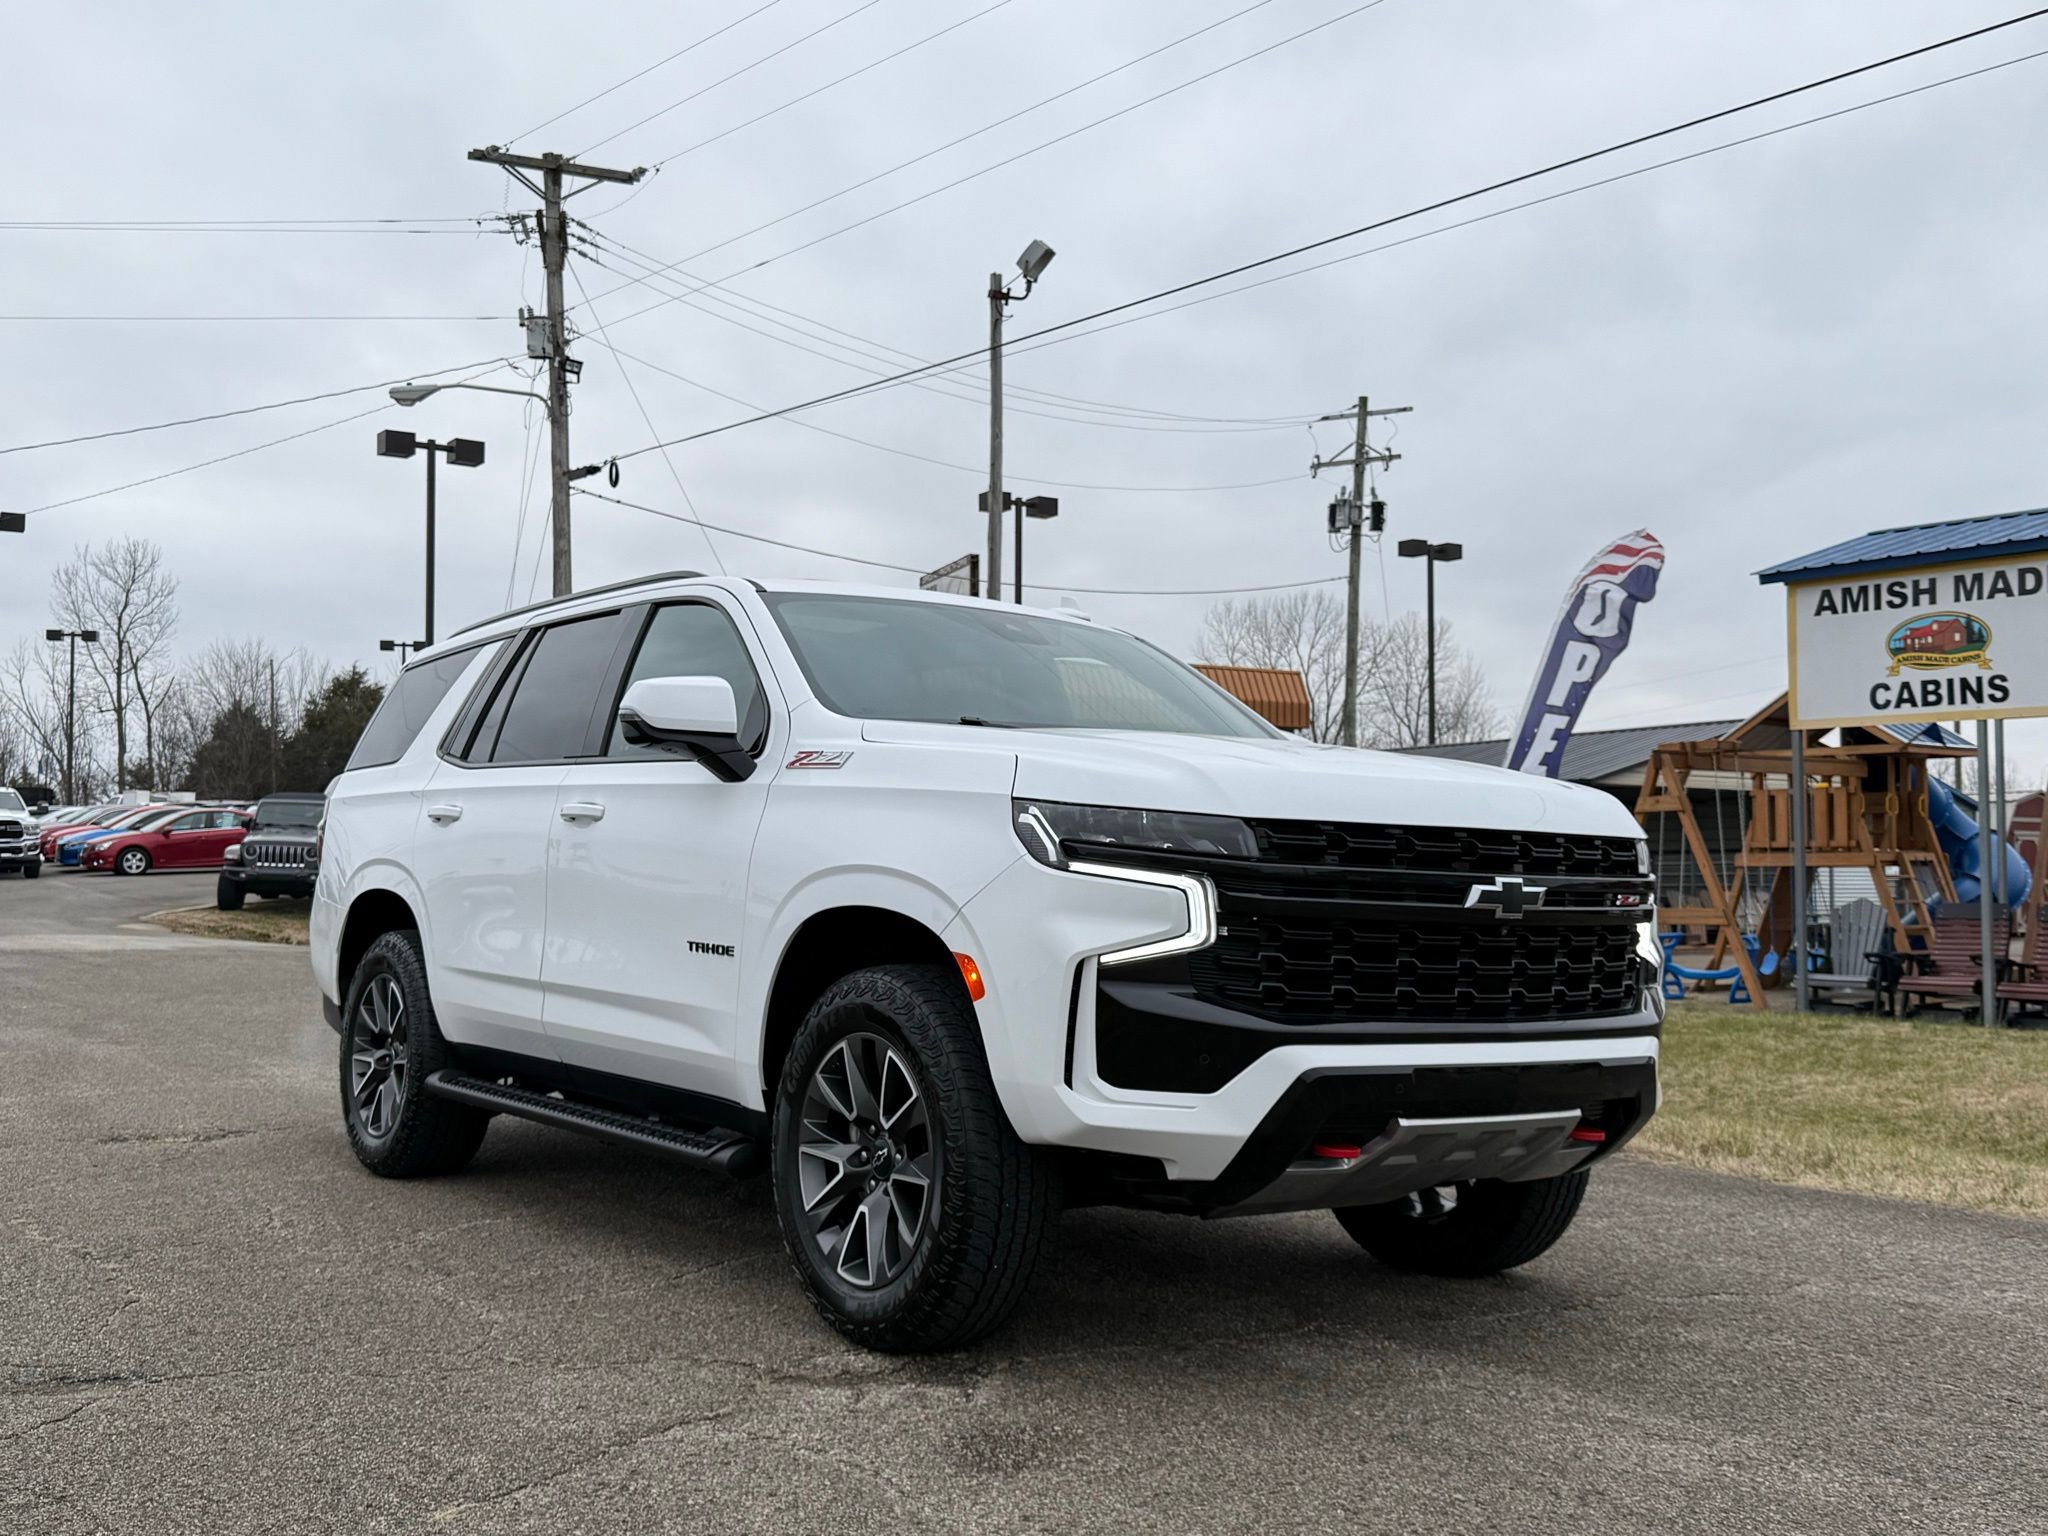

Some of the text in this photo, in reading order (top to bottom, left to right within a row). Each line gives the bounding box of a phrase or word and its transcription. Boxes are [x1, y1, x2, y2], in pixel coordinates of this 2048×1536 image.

[1814, 565, 2048, 617] AMISH MAD
[1519, 580, 1629, 778] OPE
[1869, 674, 2010, 710] CABINS
[686, 940, 735, 957] TAHOE
